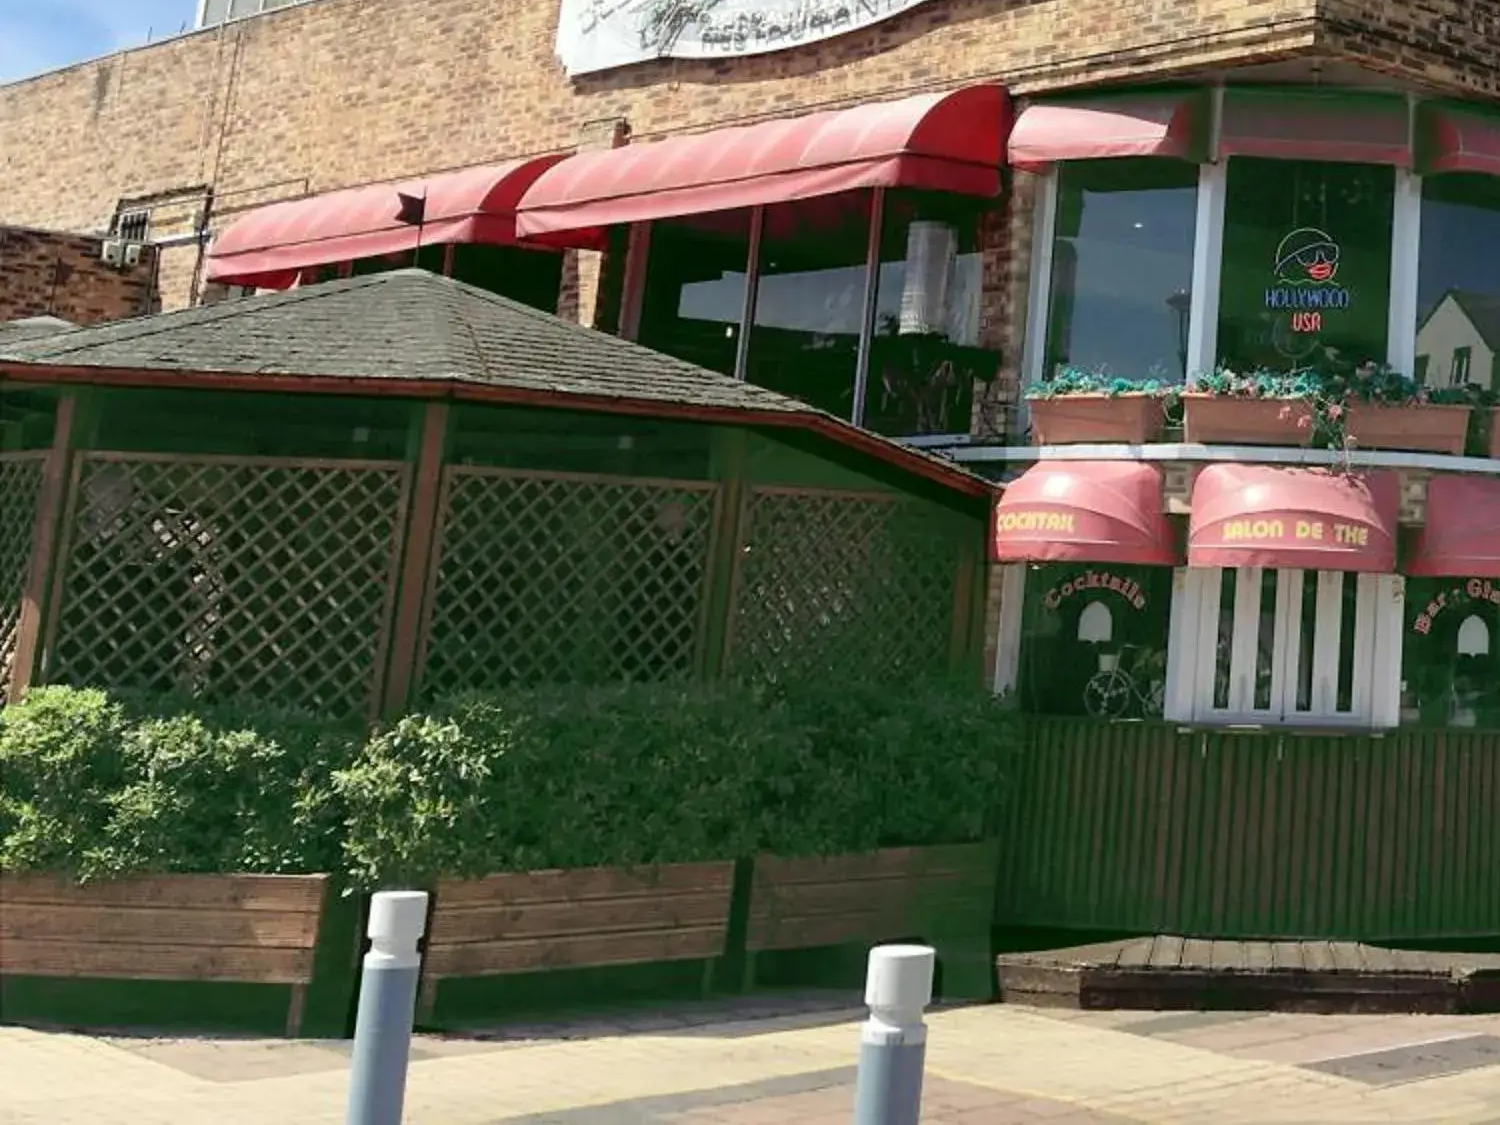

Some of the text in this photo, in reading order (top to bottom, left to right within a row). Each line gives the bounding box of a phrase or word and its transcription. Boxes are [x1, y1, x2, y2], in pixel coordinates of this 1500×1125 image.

[1264, 287, 1349, 308] HOLLYWOOD
[1292, 312, 1321, 332] USA
[1222, 520, 1369, 546] SALON DE THE
[1044, 570, 1146, 610] Cocktails
[1414, 592, 1446, 635] Bar
